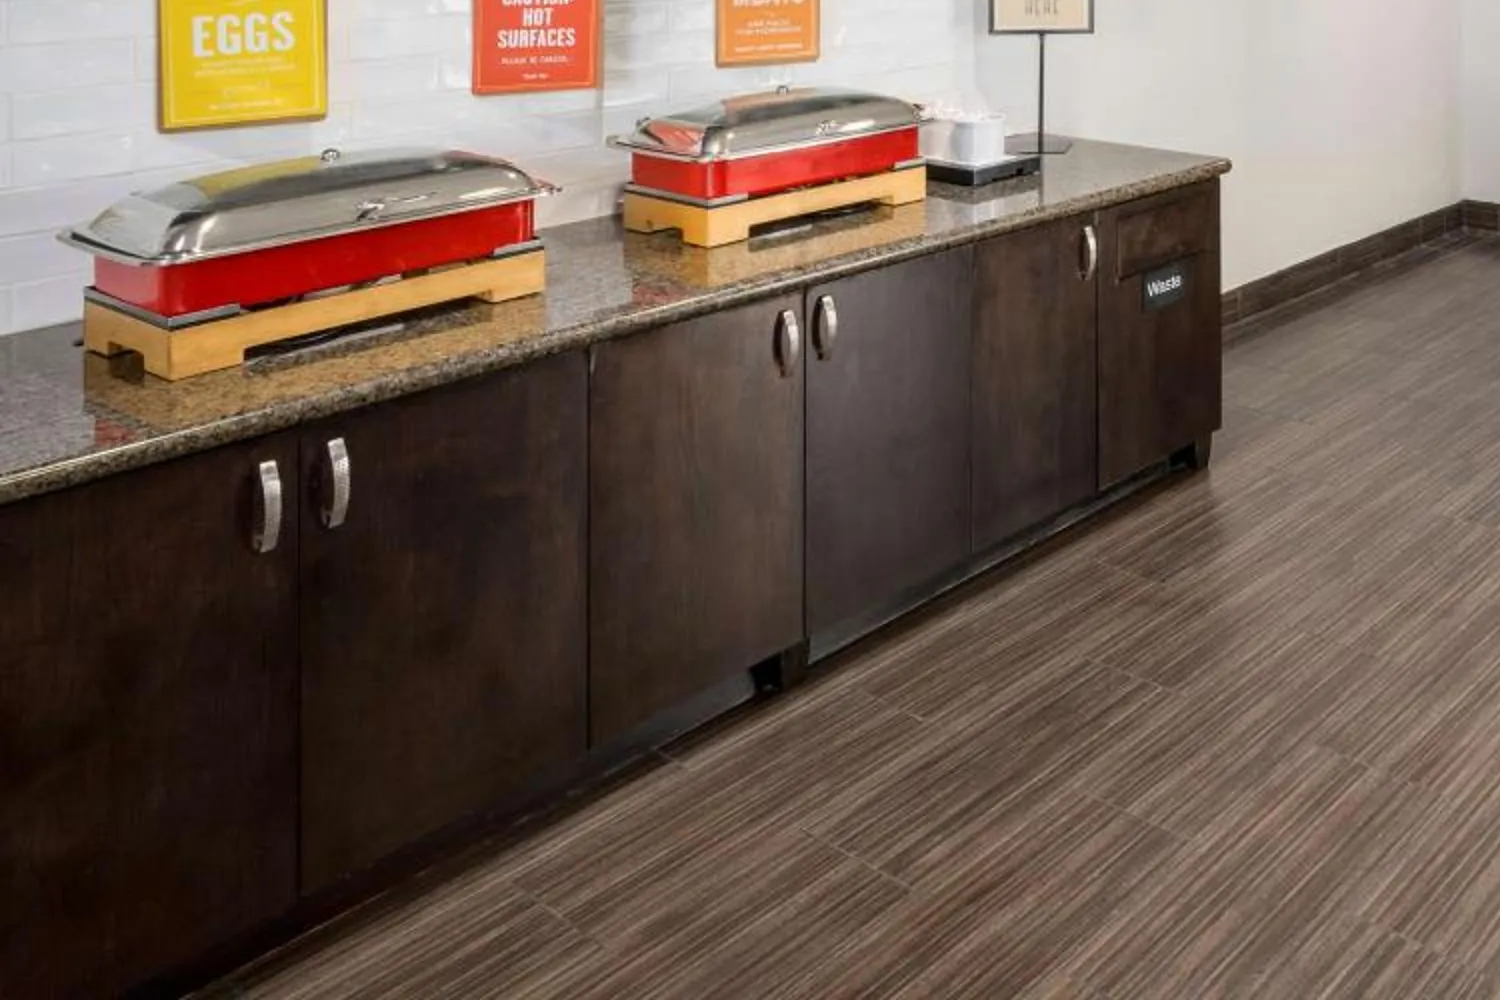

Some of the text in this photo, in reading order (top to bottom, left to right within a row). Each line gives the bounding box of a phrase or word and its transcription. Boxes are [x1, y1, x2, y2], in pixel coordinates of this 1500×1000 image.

[523, 7, 553, 27] HOT
[191, 10, 296, 58] EGGS
[497, 27, 576, 49] SURFACES
